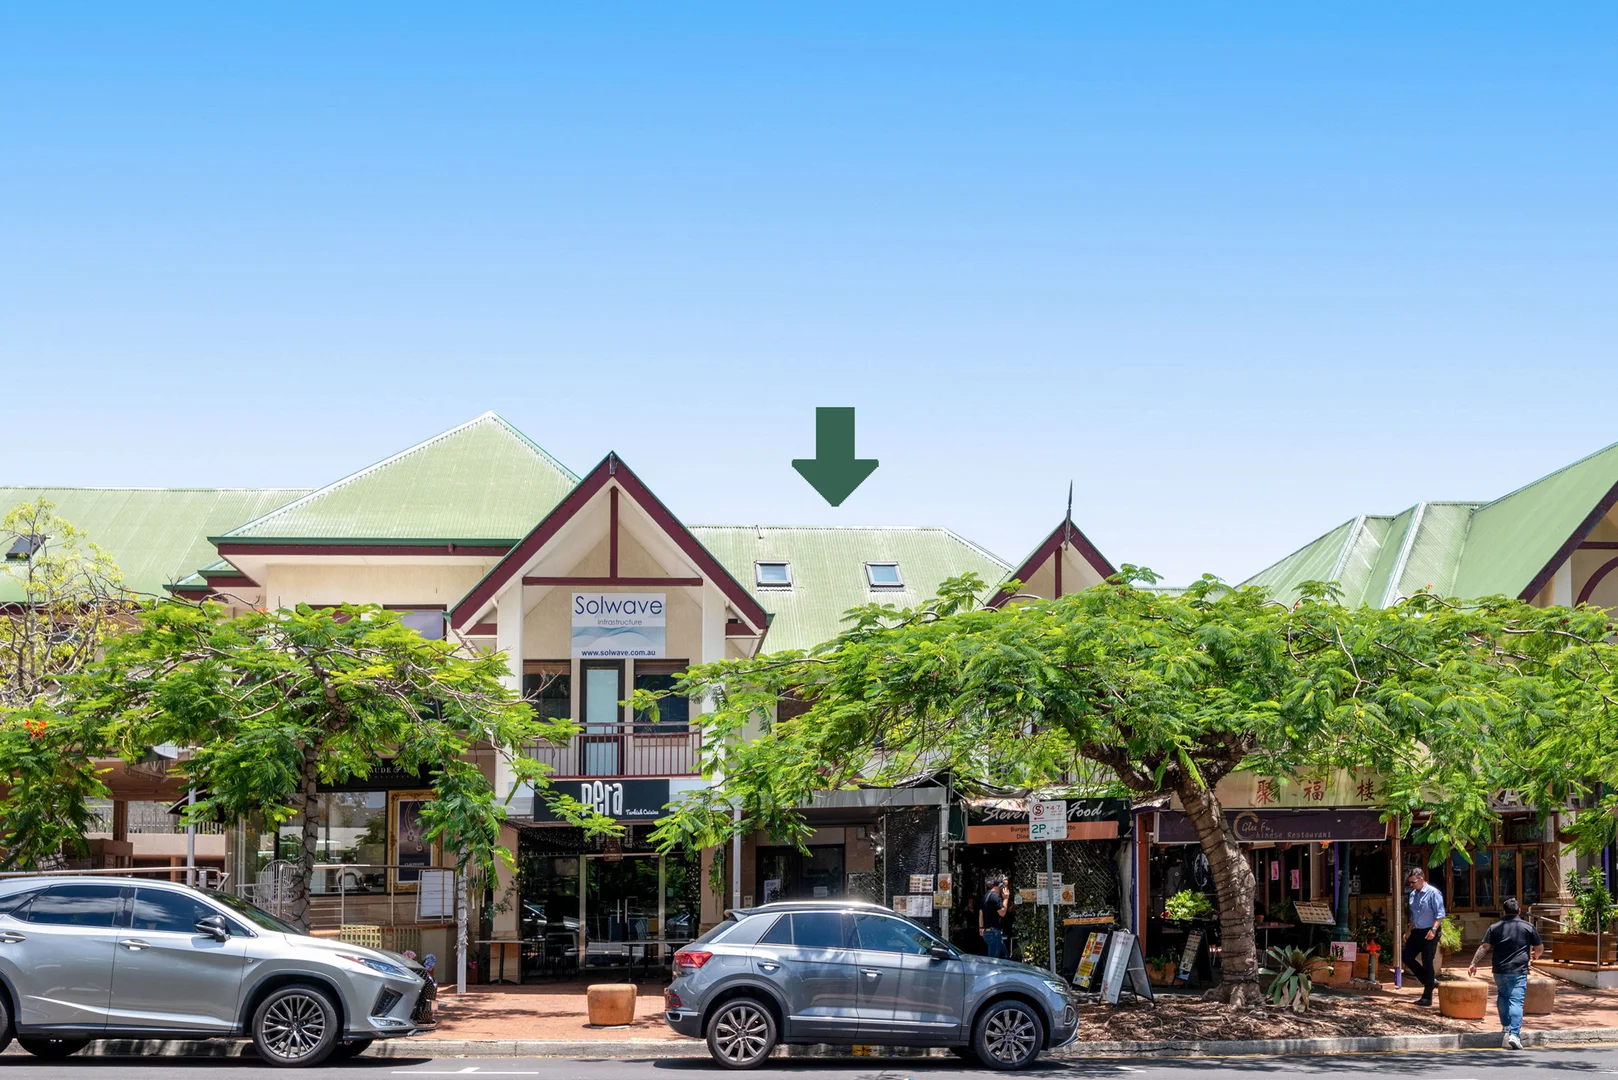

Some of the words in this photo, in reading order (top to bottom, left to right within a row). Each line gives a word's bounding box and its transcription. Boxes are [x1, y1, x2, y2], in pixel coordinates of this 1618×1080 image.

[575, 595, 663, 615] Solwave
[581, 780, 623, 817] pera
[1066, 800, 1104, 822] Food
[1031, 823, 1047, 834] 2P
[1287, 831, 1332, 840] Restaurant
